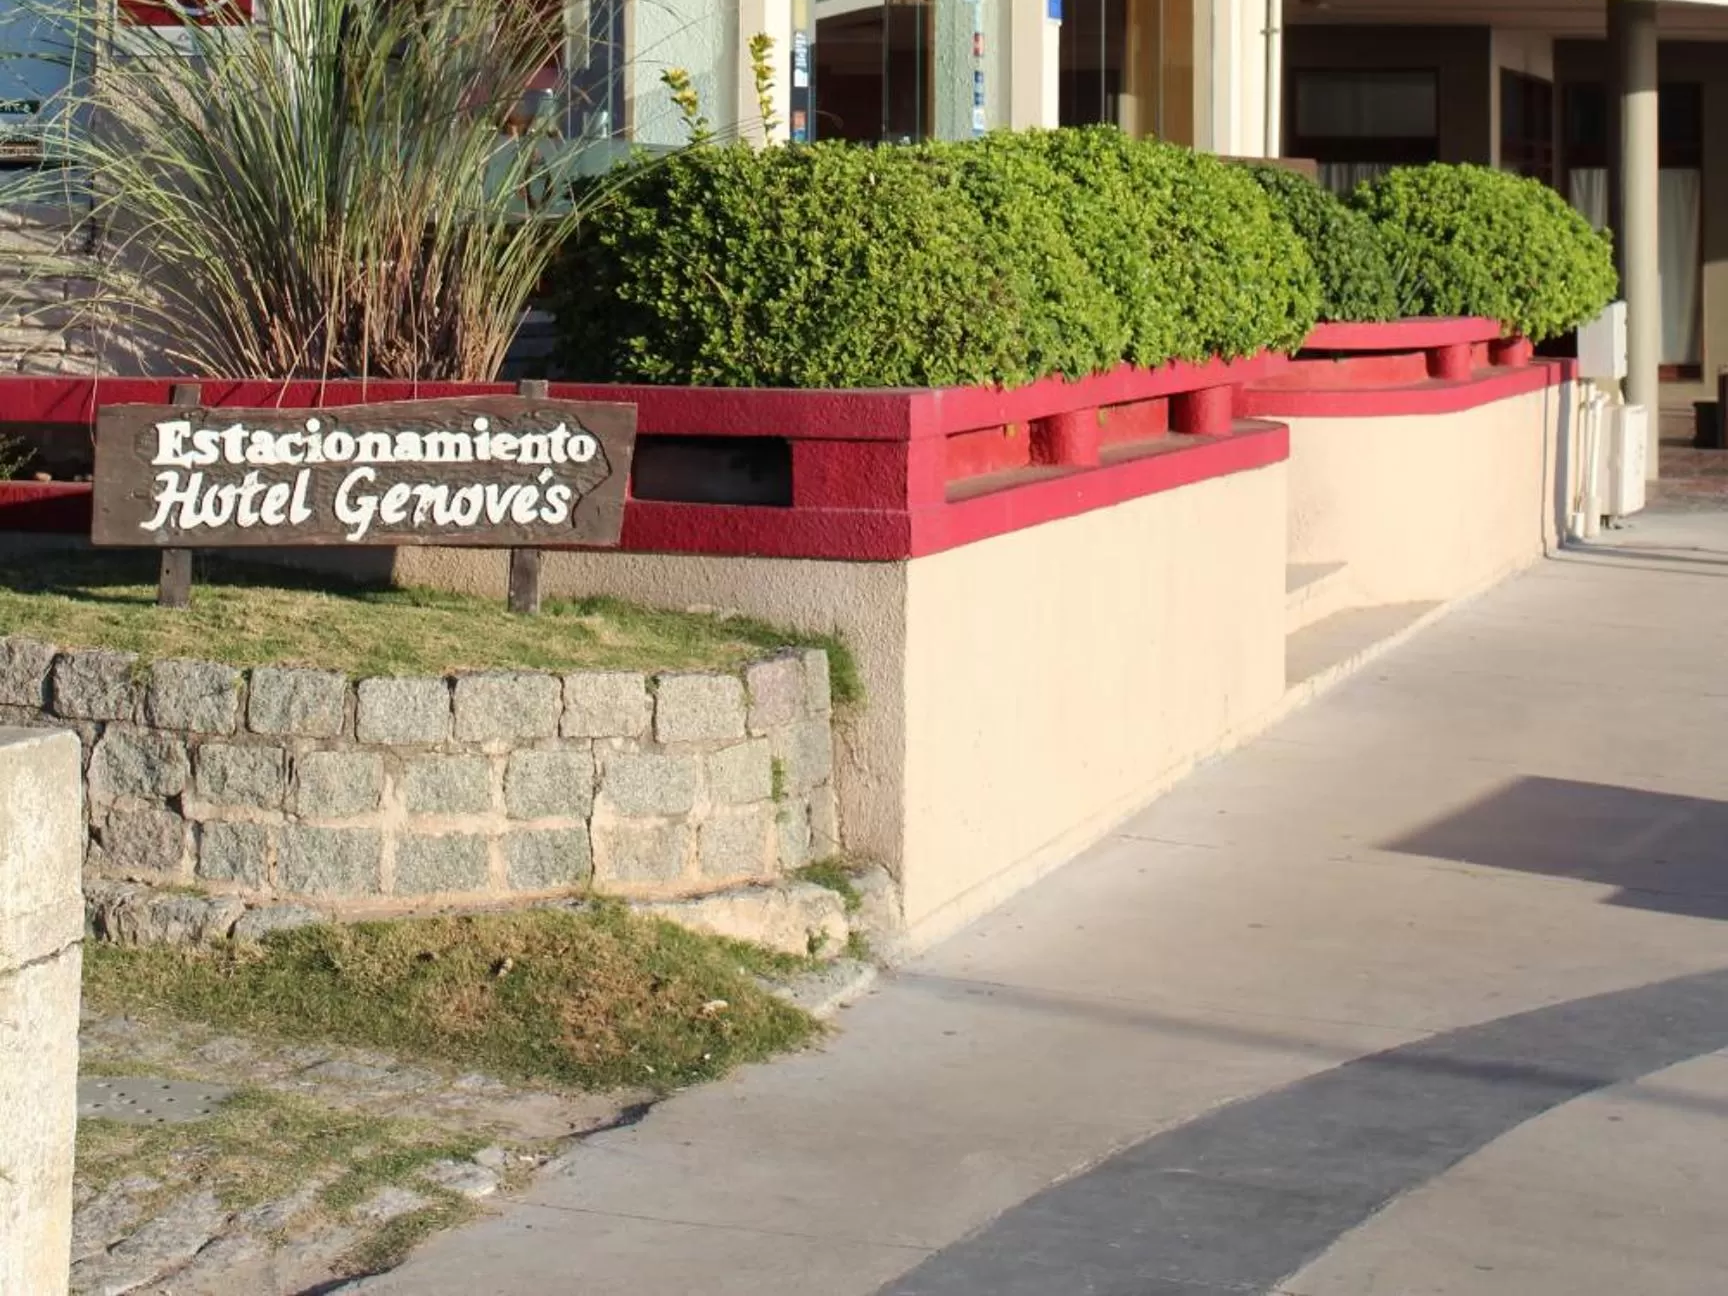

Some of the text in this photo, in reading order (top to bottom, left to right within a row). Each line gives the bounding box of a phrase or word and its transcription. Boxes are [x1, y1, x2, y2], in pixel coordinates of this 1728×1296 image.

[152, 417, 597, 466] Estacionamiento
[140, 467, 573, 541] Hotel Genovés
